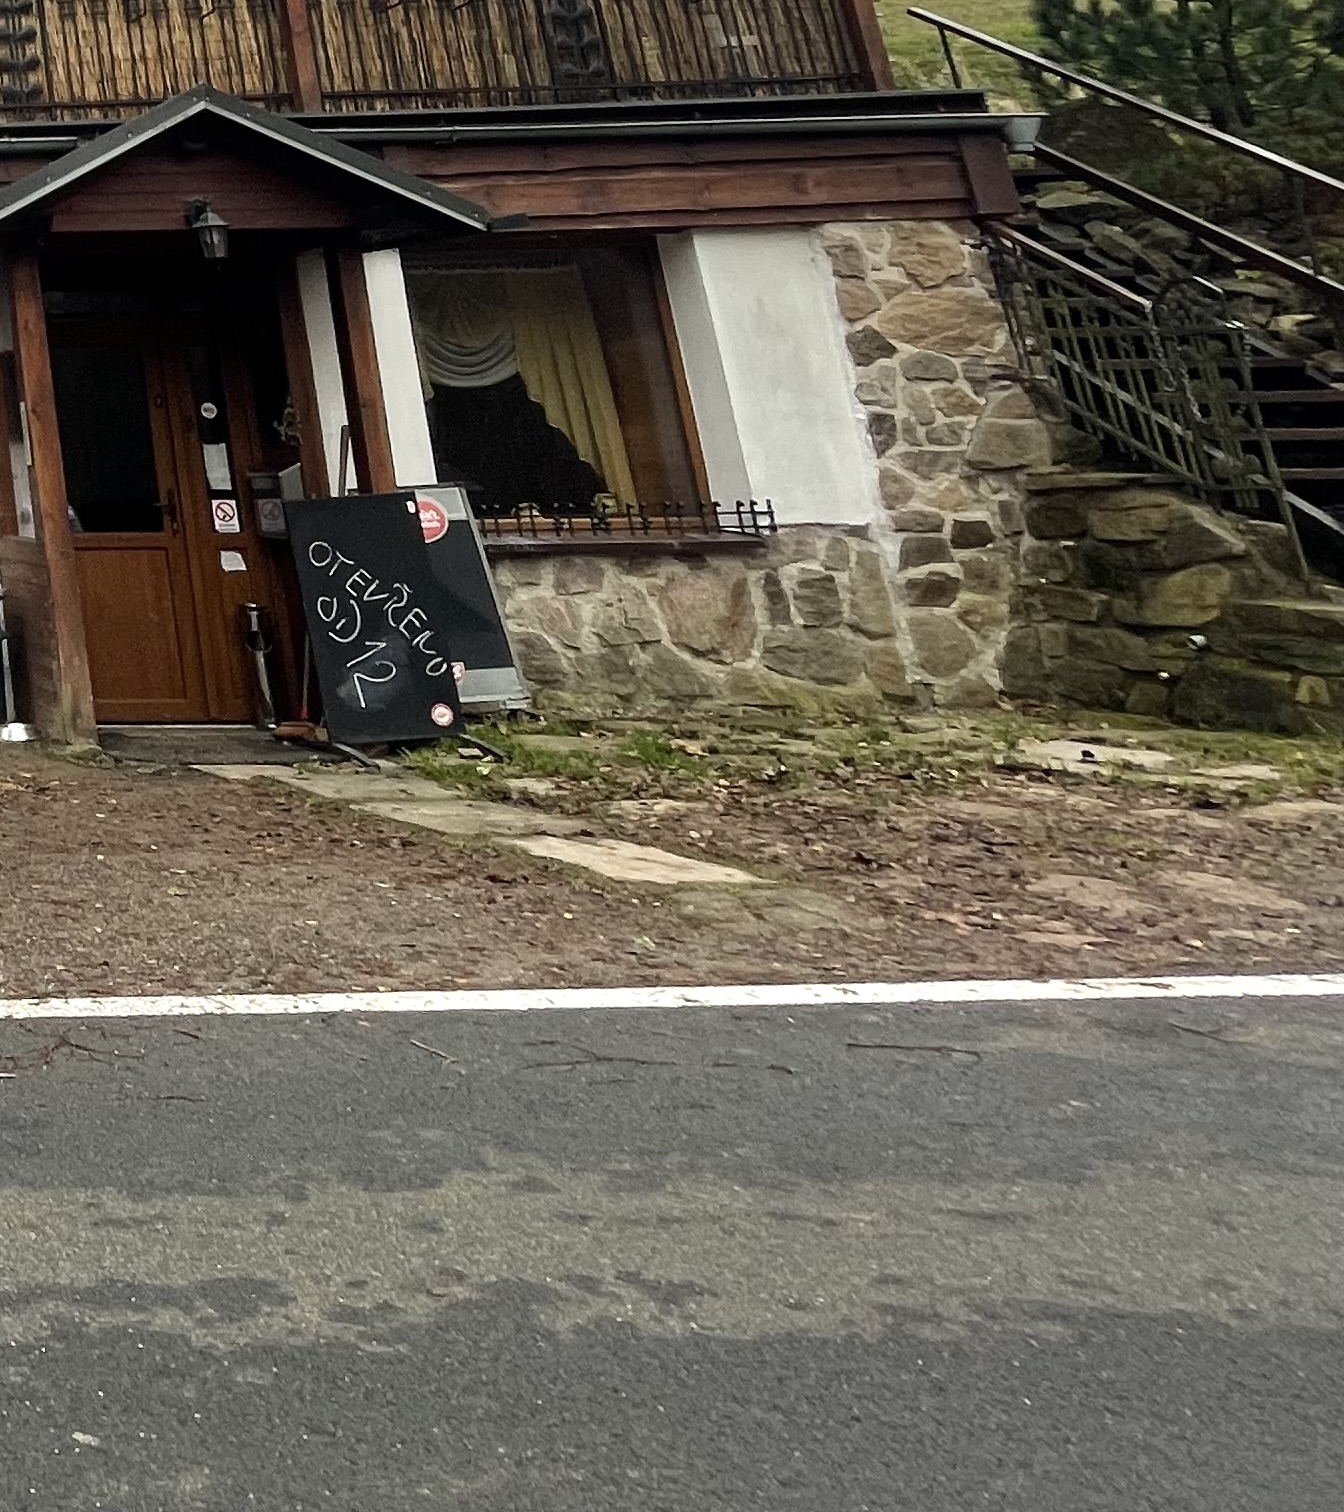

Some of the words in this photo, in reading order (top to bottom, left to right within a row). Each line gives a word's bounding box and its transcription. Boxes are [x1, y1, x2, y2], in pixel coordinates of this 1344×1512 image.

[308, 541, 448, 677] OTEVŘENO
[316, 596, 362, 643] OD
[346, 641, 397, 709] 12
